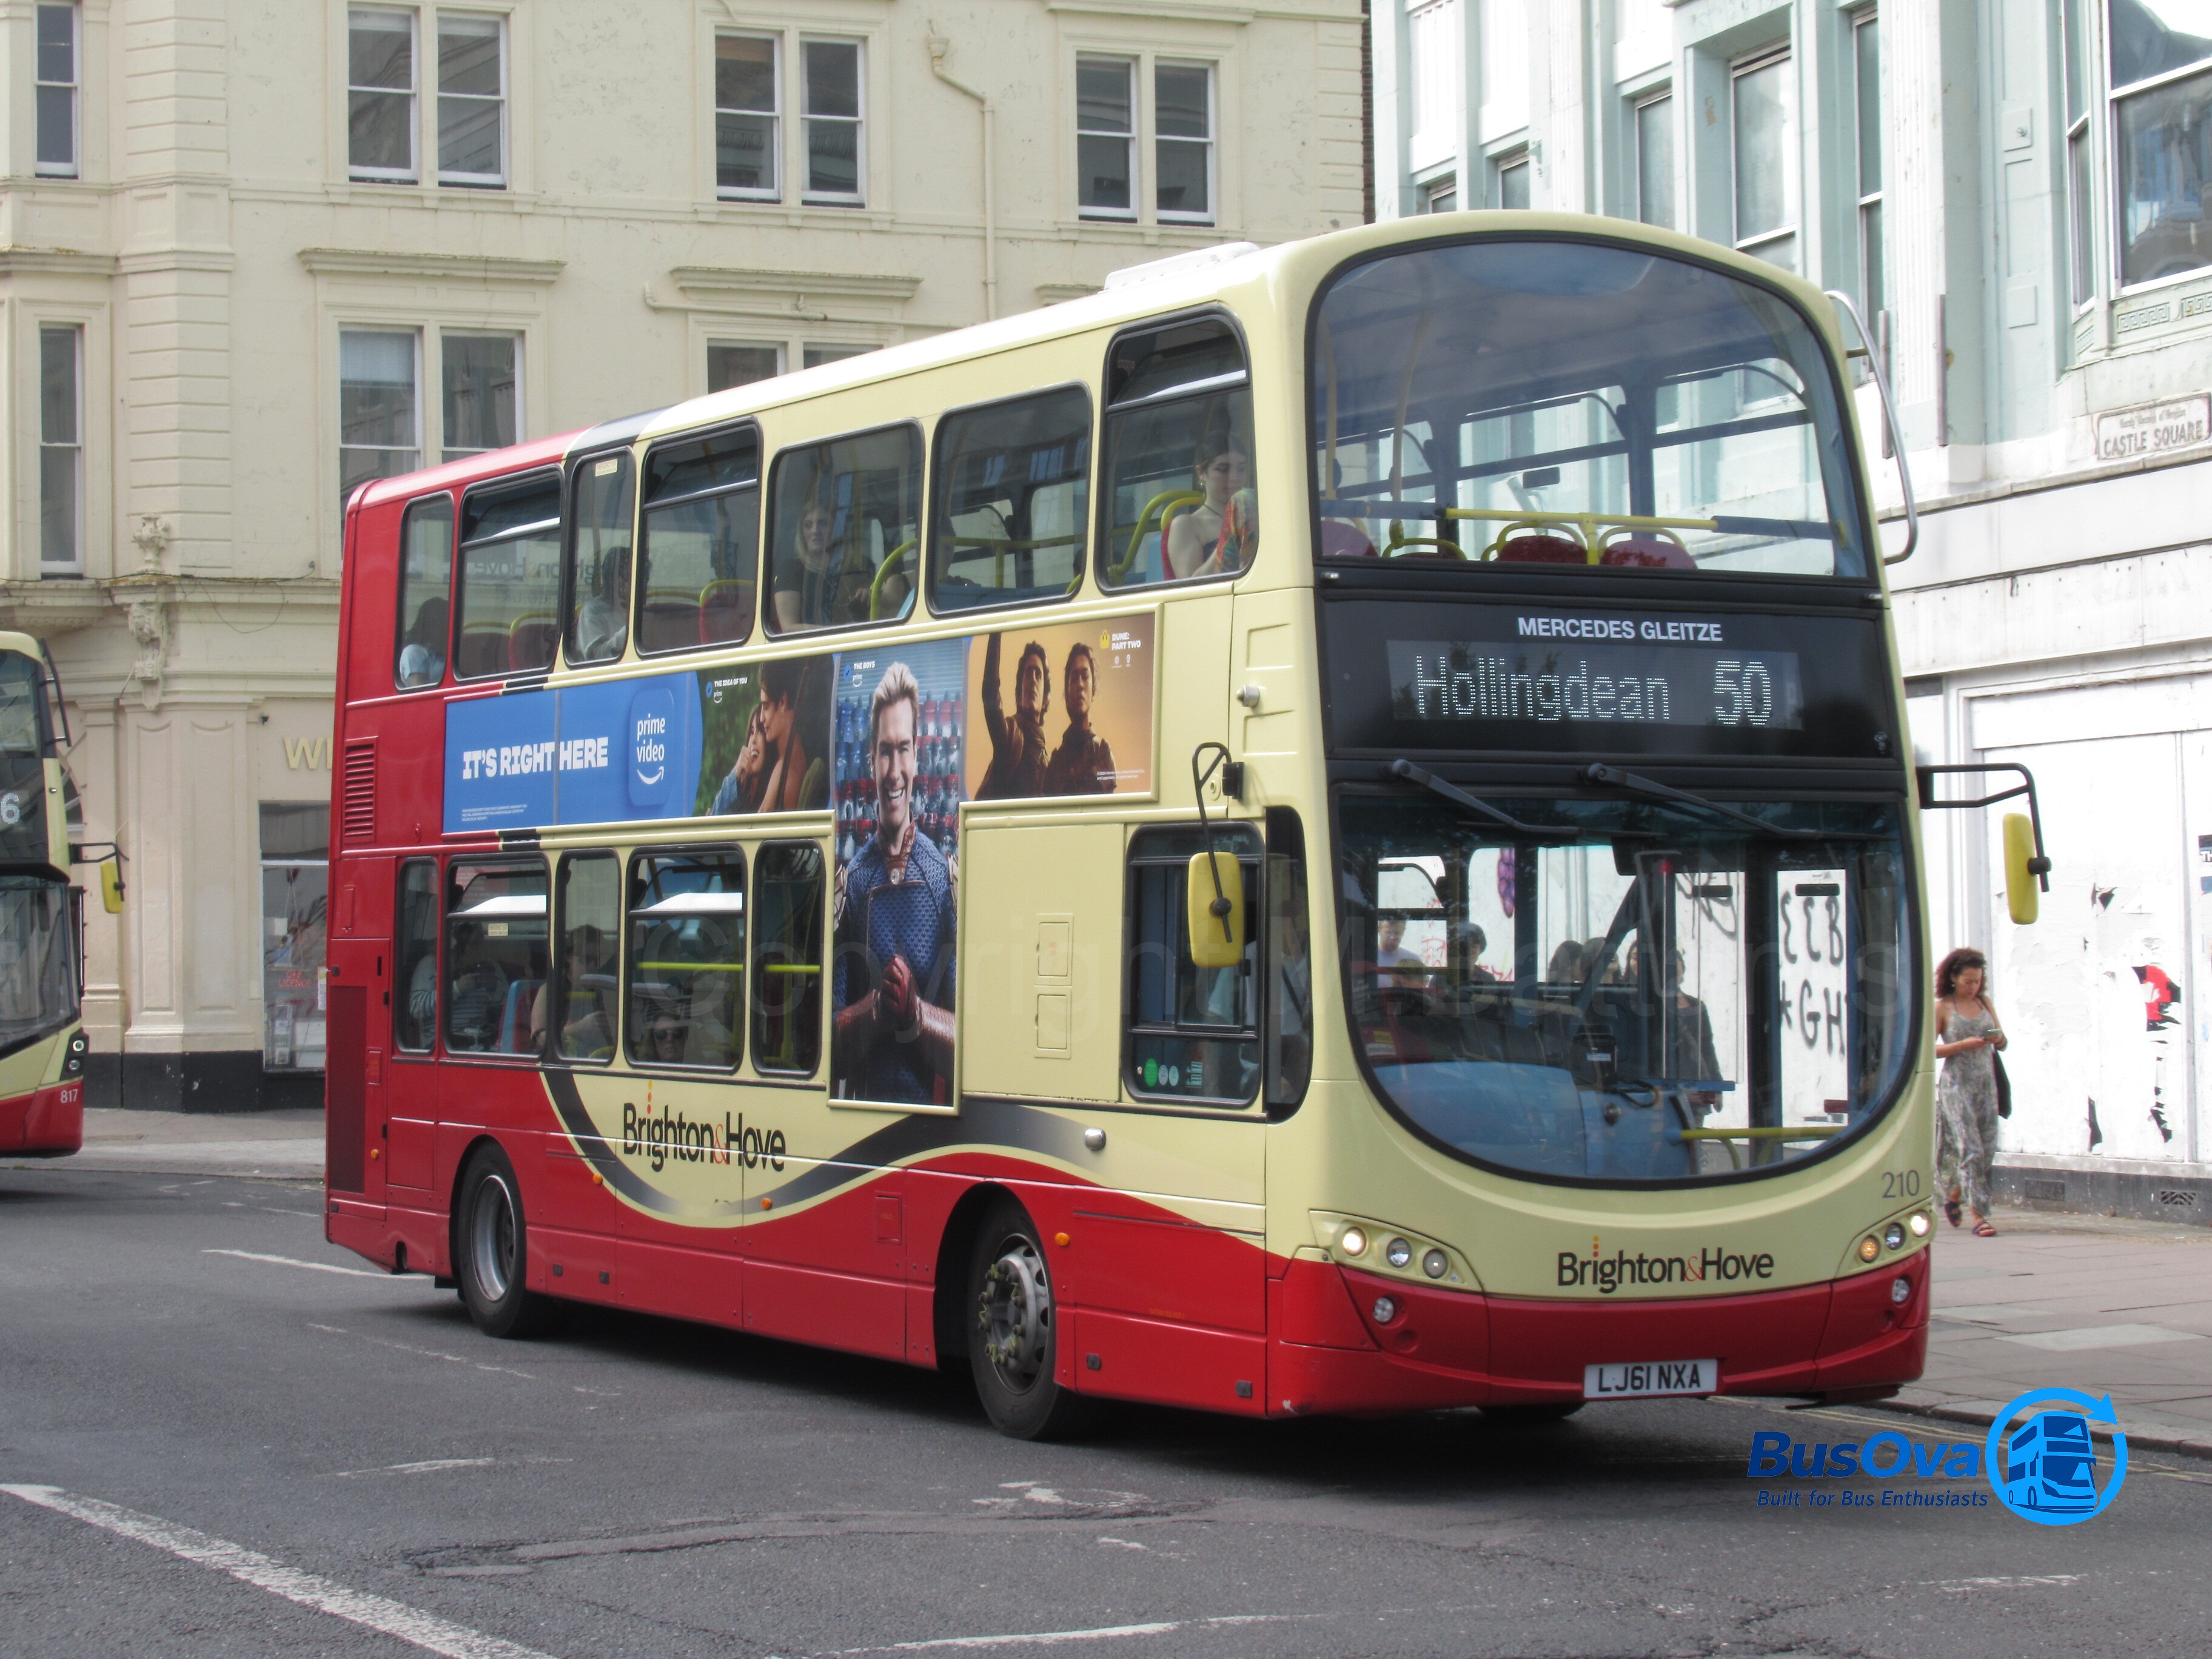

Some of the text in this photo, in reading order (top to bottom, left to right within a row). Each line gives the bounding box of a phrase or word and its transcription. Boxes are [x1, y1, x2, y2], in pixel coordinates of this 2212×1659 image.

[2103, 420, 2202, 457] CASTLE SQUARE
[1111, 632, 1130, 641] DUNE:
[1518, 617, 1723, 642] MERCEDES GLEITZE
[1111, 640, 1141, 651] PART TWO
[1415, 655, 1772, 726] Hollingdean 50
[637, 713, 666, 740] prime
[463, 737, 609, 780] IT'S RIGHT HERE
[637, 741, 665, 763] video
[1, 793, 20, 824] 6
[278, 979, 312, 988] LICENCE
[286, 970, 303, 979] OFF
[60, 1089, 78, 1104] 817
[623, 1102, 786, 1172] Brighton&Hove
[1882, 1169, 1920, 1199] 210
[1558, 1247, 1775, 1294] Brighton&Hove
[1598, 1363, 1701, 1393] LJ61 NXA
